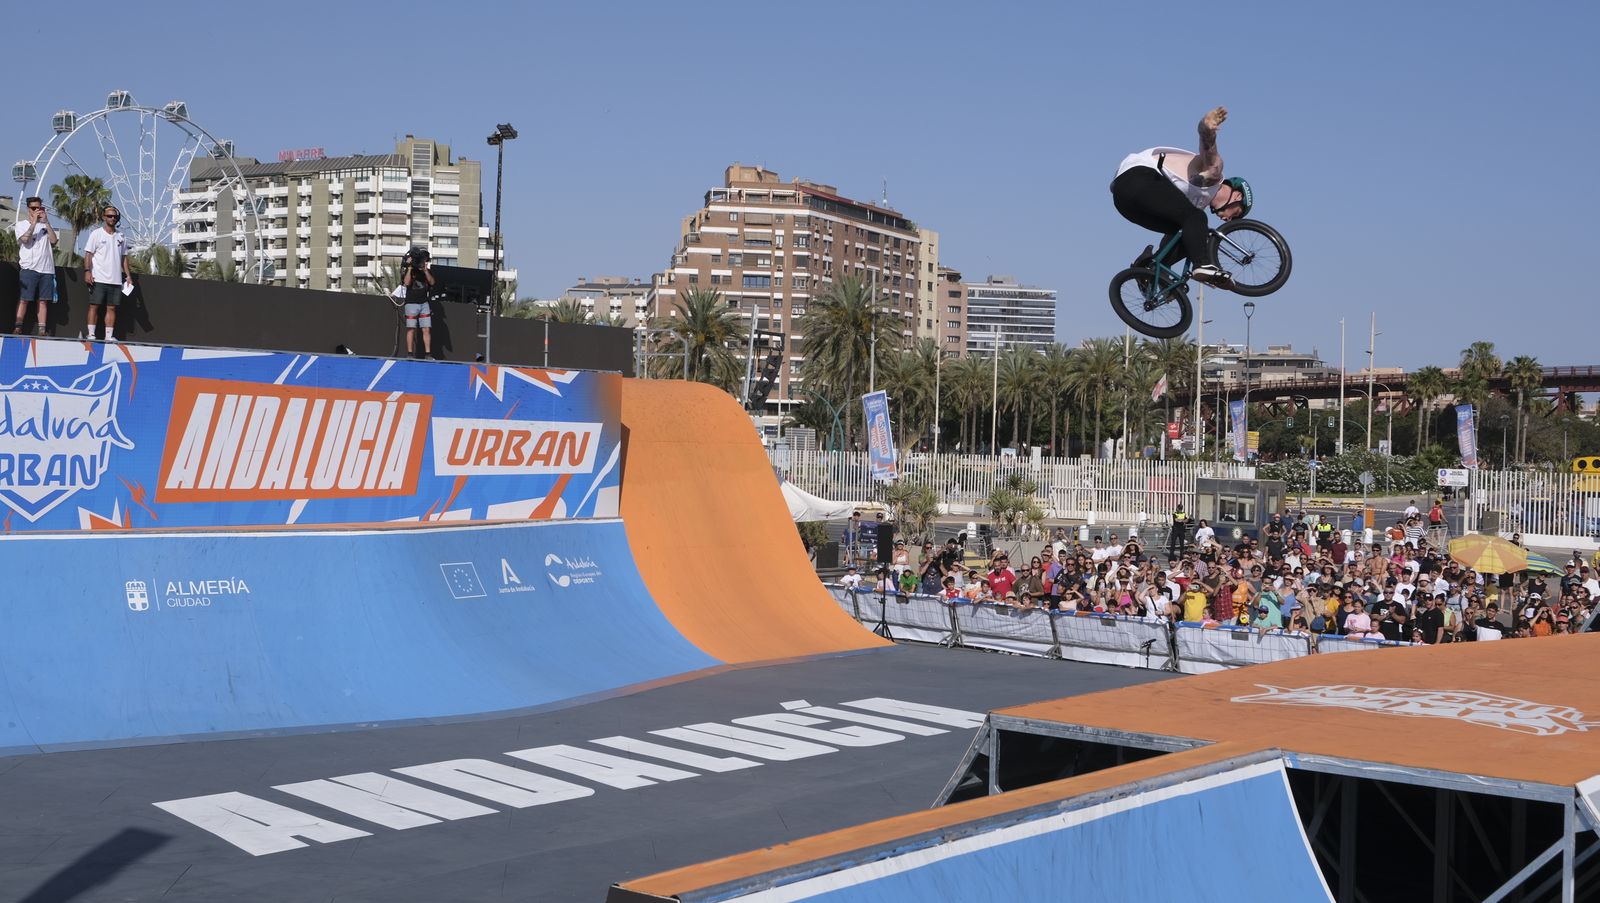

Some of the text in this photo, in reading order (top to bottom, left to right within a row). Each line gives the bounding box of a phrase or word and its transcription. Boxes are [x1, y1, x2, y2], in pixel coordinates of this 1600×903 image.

[165, 391, 421, 490] ANDALUCÍA
[447, 428, 591, 467] URBAN
[166, 577, 250, 596] ALMERÍA
[167, 597, 211, 608] CIUDAD
